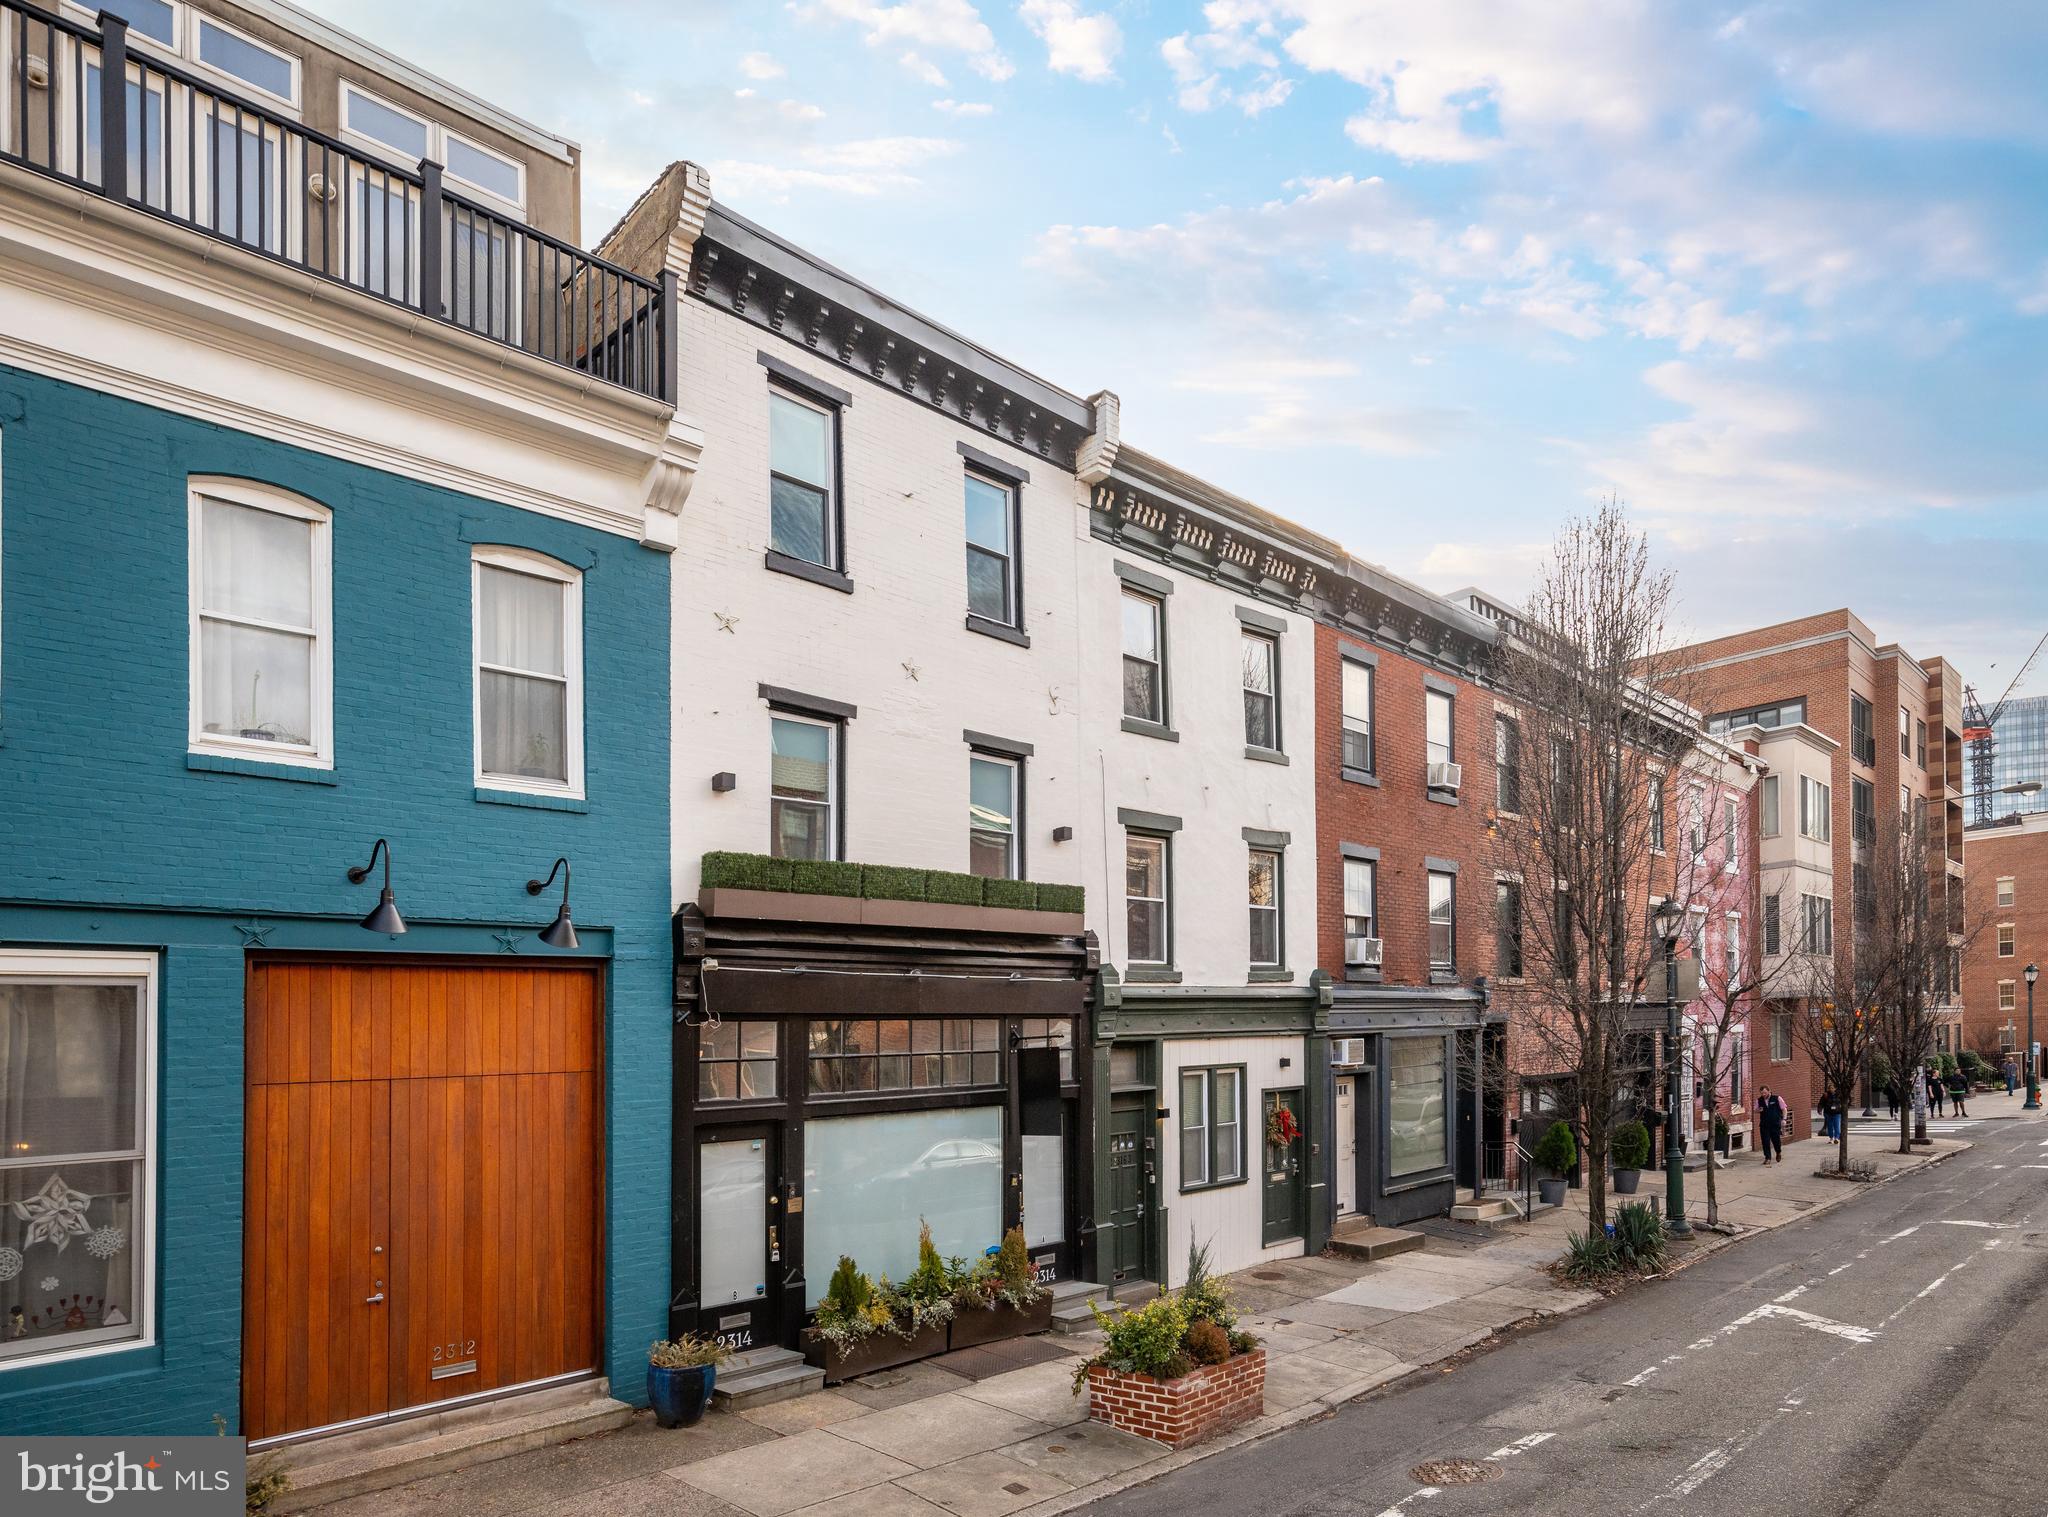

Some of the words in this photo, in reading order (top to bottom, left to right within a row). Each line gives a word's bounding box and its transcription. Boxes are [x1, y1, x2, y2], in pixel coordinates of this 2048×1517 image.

[1033, 1268, 1056, 1284] 2314
[433, 1340, 475, 1361] 2312
[717, 1330, 752, 1351] 2314
